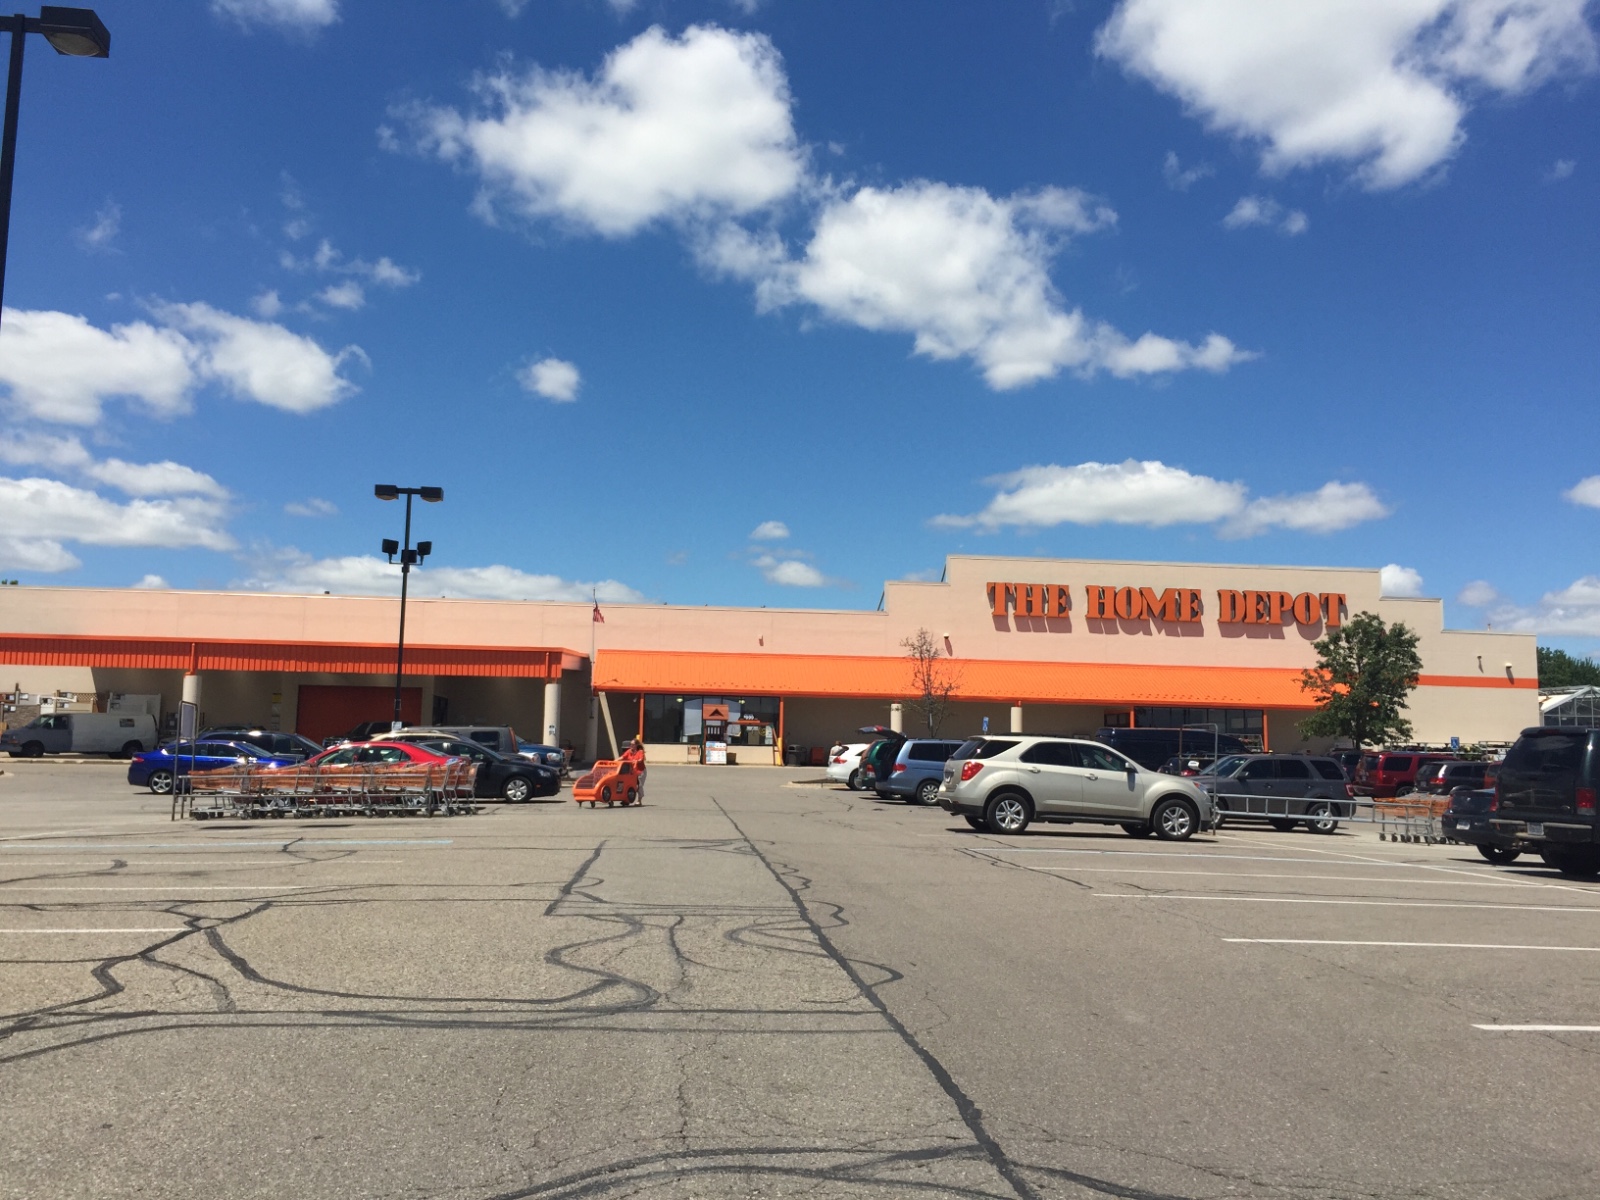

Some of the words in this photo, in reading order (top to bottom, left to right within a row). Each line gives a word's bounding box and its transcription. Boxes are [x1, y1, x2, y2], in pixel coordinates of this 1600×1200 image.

[986, 582, 1070, 618] THE
[1085, 585, 1202, 622] HOME
[1217, 589, 1346, 627] DEPOT
